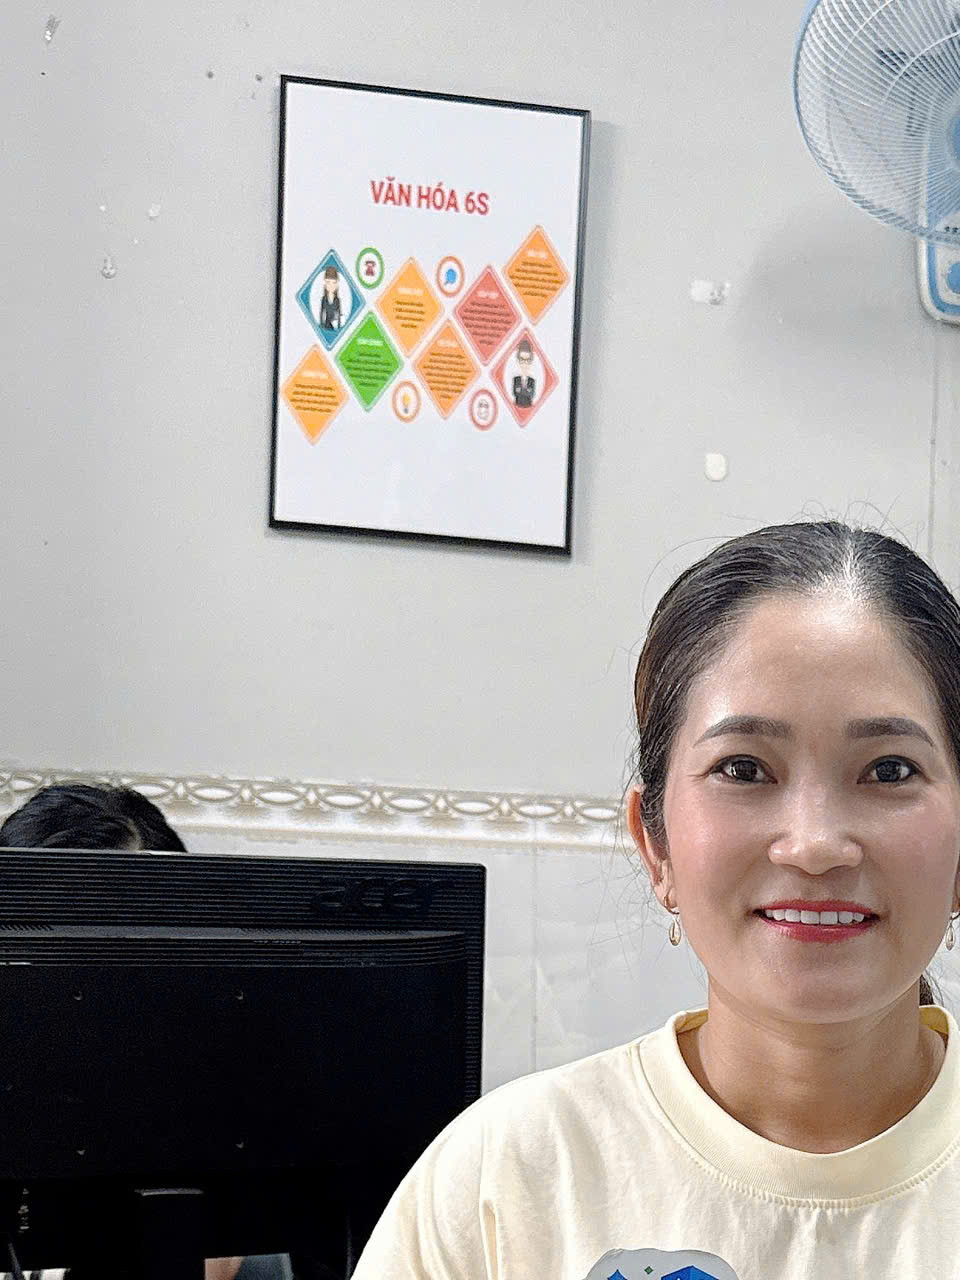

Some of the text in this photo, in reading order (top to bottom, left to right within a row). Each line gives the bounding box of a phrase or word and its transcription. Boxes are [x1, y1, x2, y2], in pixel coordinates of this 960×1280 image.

[370, 176, 490, 216] VĂN HÓA 6S
